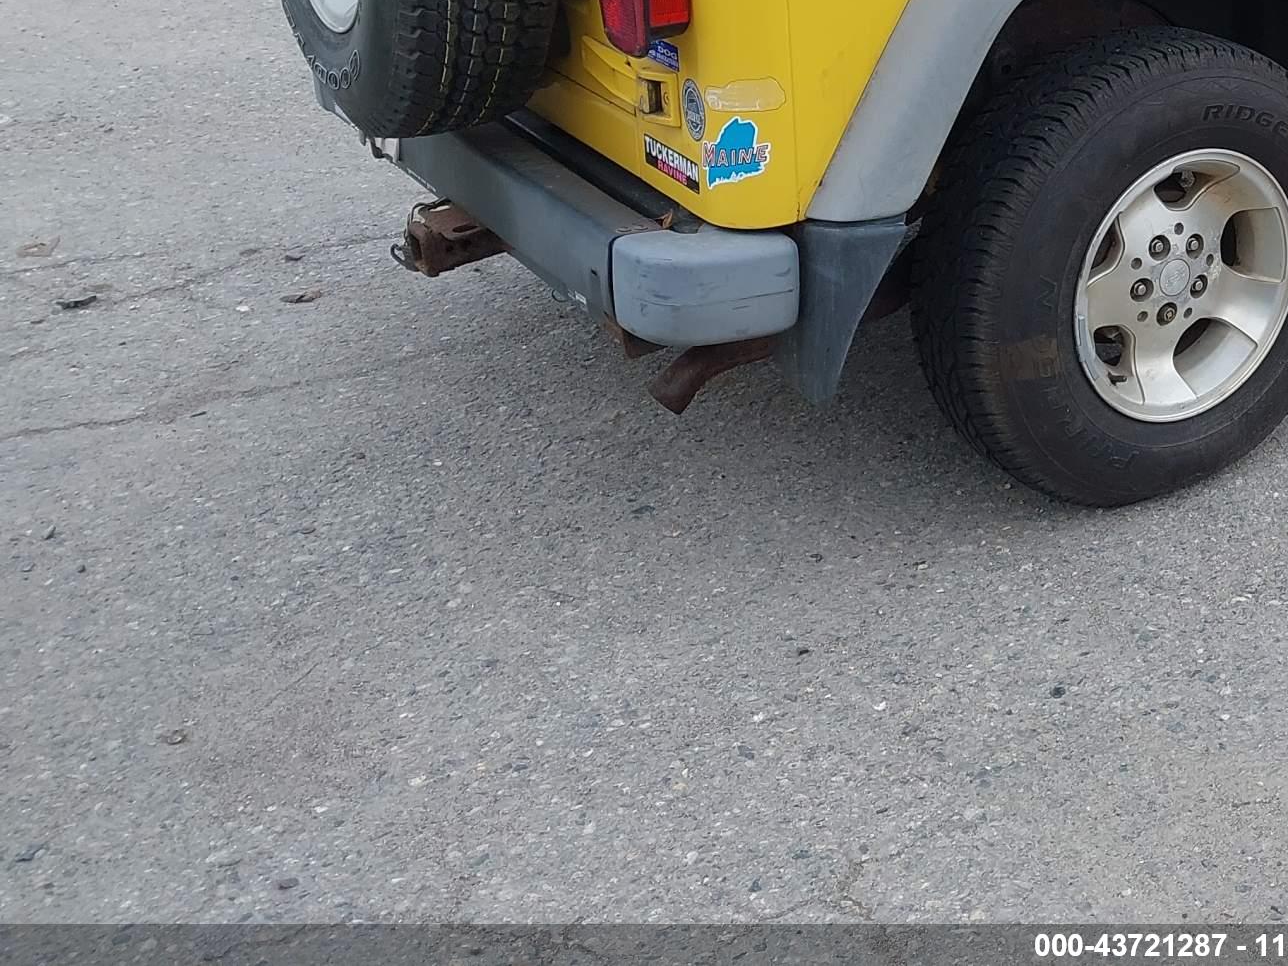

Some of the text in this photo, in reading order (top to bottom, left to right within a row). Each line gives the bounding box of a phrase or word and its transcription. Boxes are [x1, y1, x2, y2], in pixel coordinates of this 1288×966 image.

[644, 135, 700, 183] TUCKERMAN
[702, 141, 770, 169] MAINE
[657, 160, 688, 186] RAVINE
